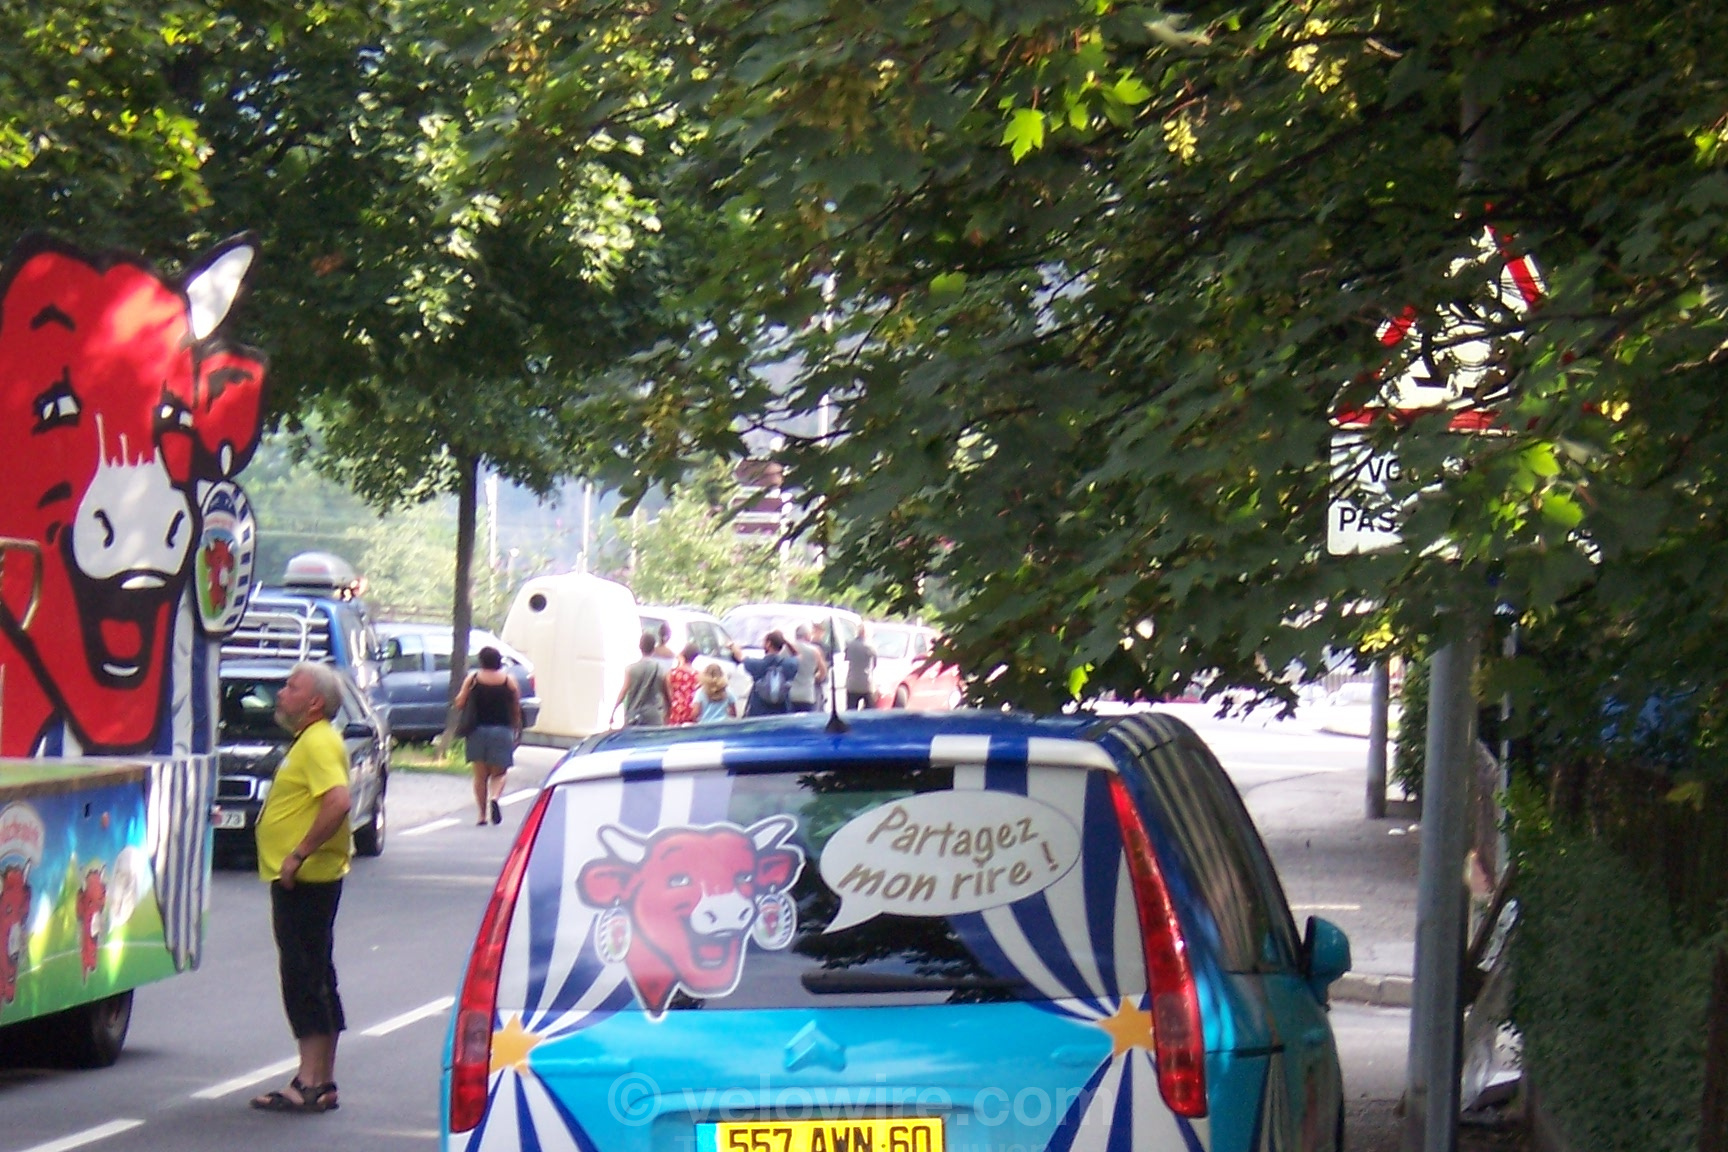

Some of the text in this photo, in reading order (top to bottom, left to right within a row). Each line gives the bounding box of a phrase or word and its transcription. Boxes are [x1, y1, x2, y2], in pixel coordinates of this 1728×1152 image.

[1338, 507, 1396, 532] PAS
[866, 805, 1039, 868] Partagez
[837, 862, 938, 902] mon
